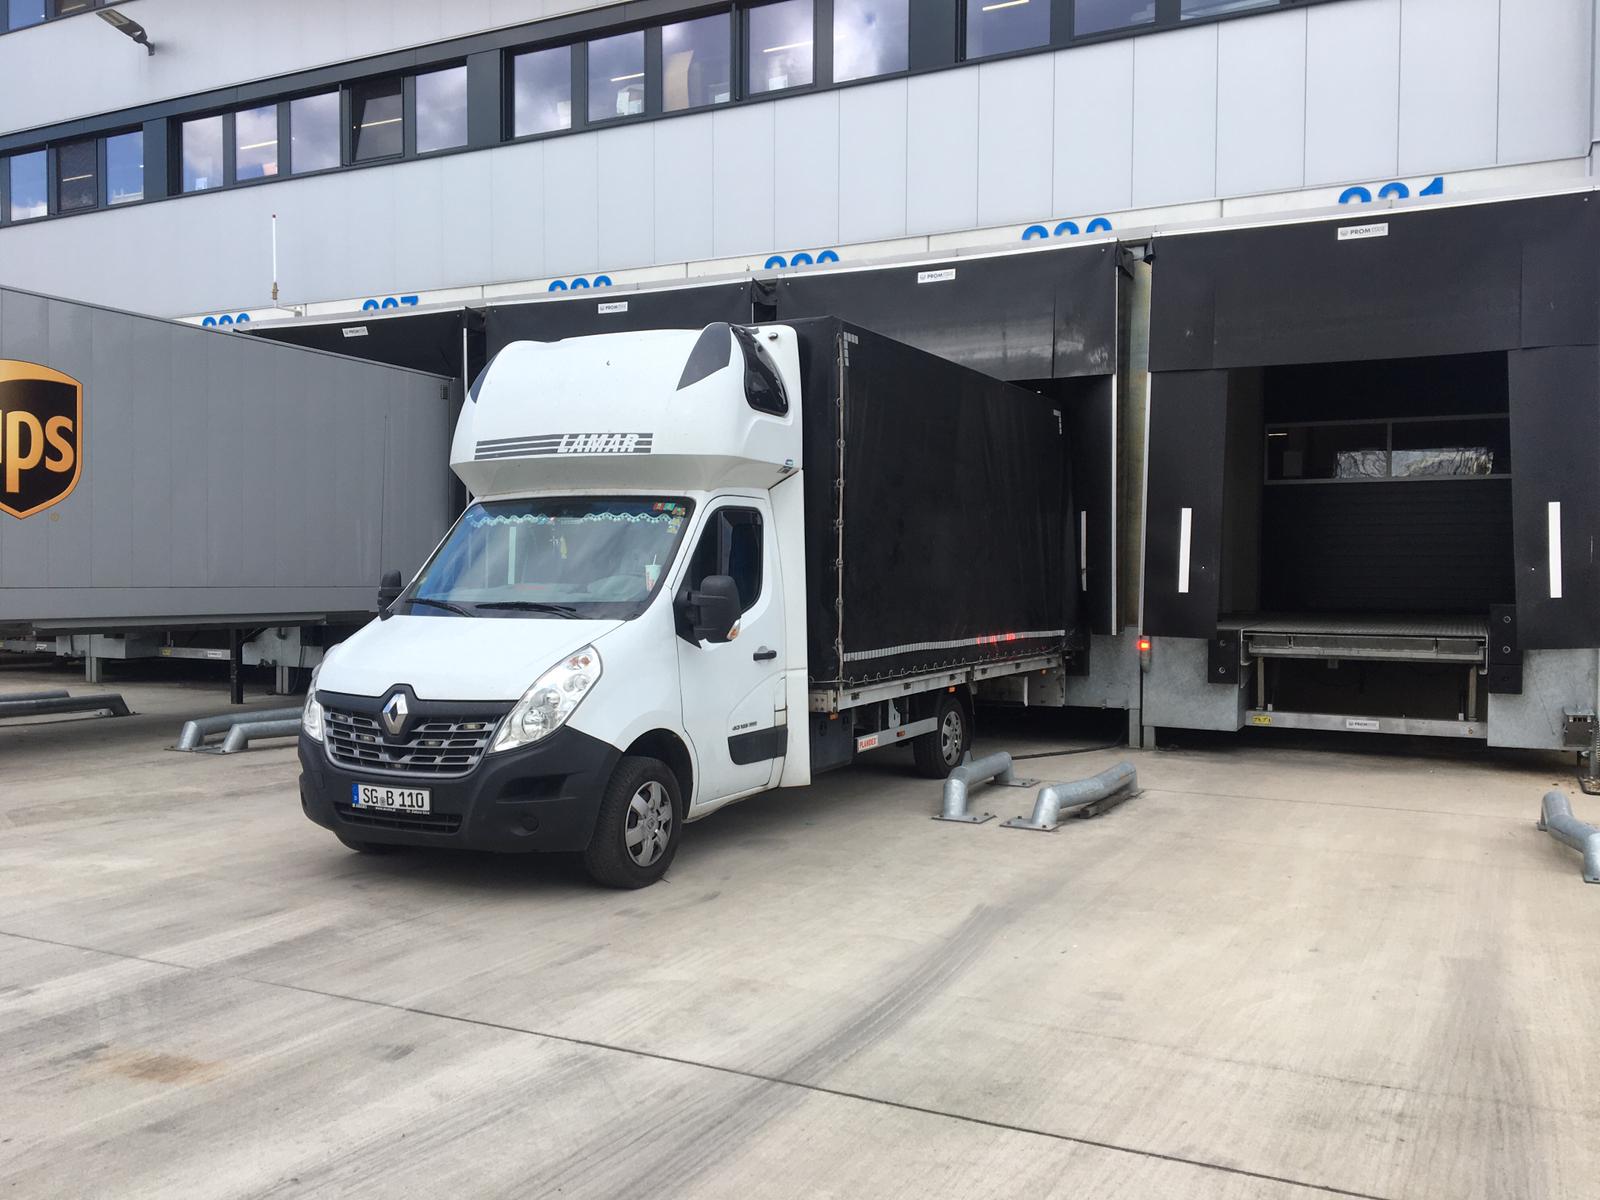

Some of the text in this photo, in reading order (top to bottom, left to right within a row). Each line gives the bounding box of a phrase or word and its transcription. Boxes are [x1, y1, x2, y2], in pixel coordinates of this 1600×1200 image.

[0, 410, 75, 494] ps
[557, 433, 639, 453] LAMAR
[363, 788, 424, 808] SG B 110
